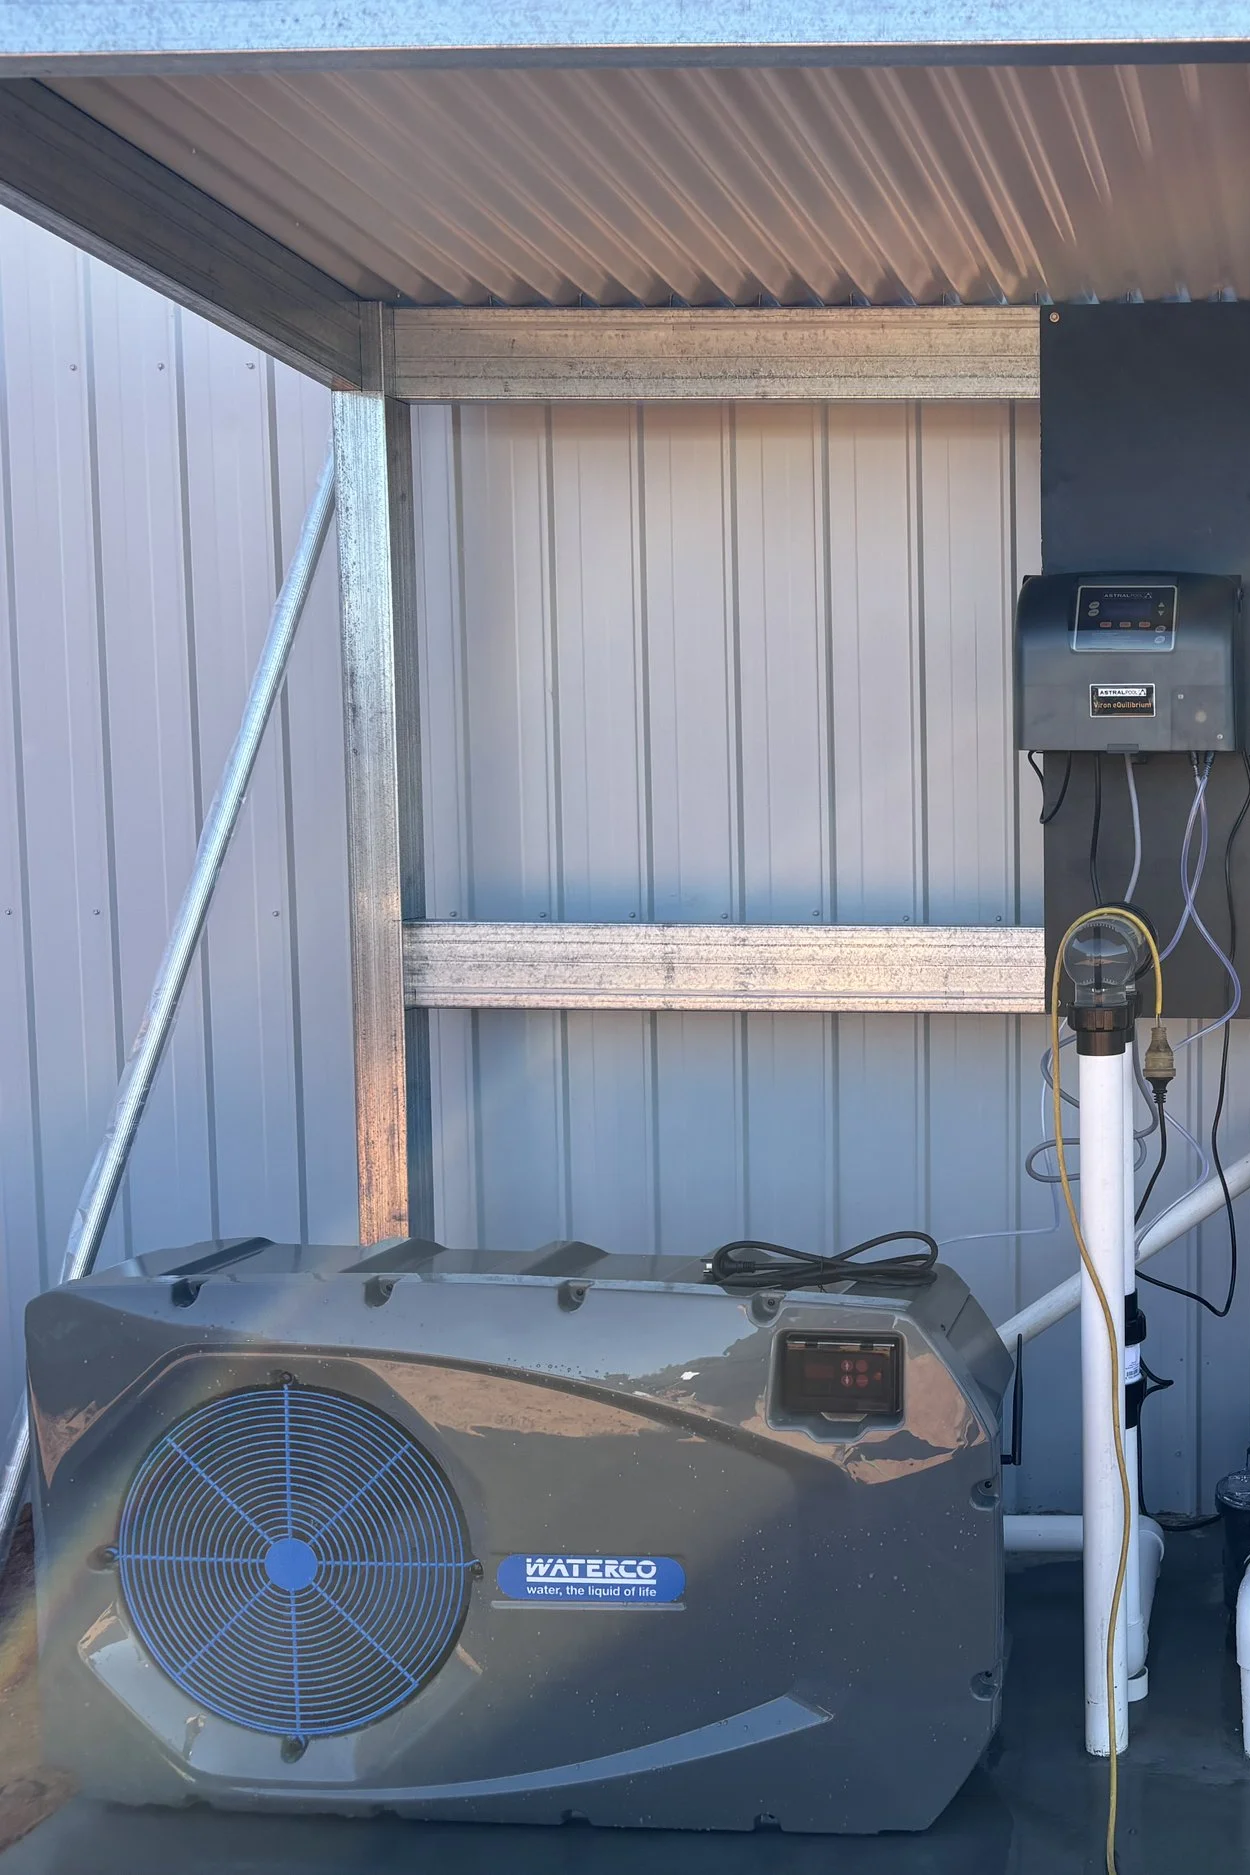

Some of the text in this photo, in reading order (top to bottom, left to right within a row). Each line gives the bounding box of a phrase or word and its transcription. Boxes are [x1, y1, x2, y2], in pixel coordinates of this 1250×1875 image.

[1112, 701, 1152, 709] eQuilibrium
[526, 1557, 657, 1579] WATERCO
[526, 1586, 657, 1598] water, the liquid of life
